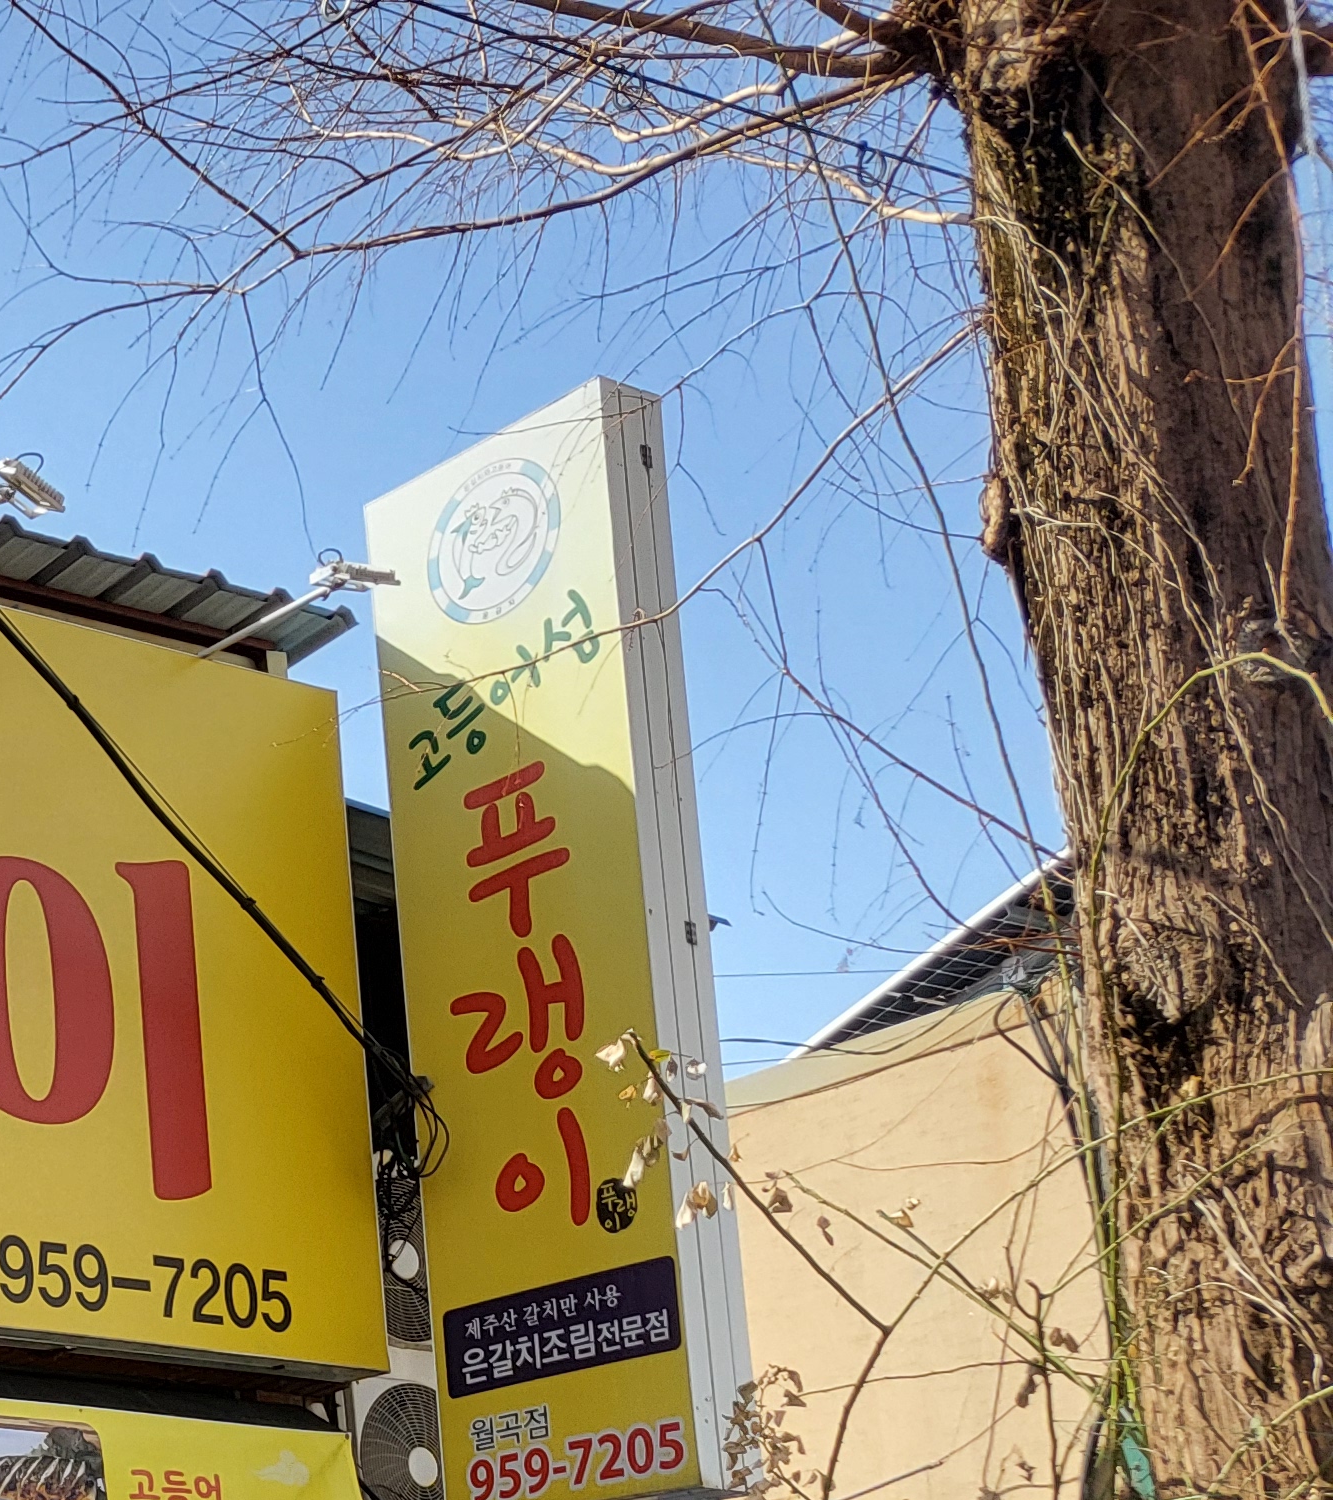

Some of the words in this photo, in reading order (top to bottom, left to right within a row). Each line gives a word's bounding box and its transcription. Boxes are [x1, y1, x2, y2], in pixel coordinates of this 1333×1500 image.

[409, 588, 600, 790] 고등어섬
[450, 761, 591, 1226] 푸랭이
[461, 1308, 671, 1386] 은갈치조림전문점
[464, 1311, 518, 1340] 제주산
[522, 1295, 578, 1329] 갈치만
[583, 1284, 622, 1312] 사용
[469, 1405, 550, 1452] 월곡점
